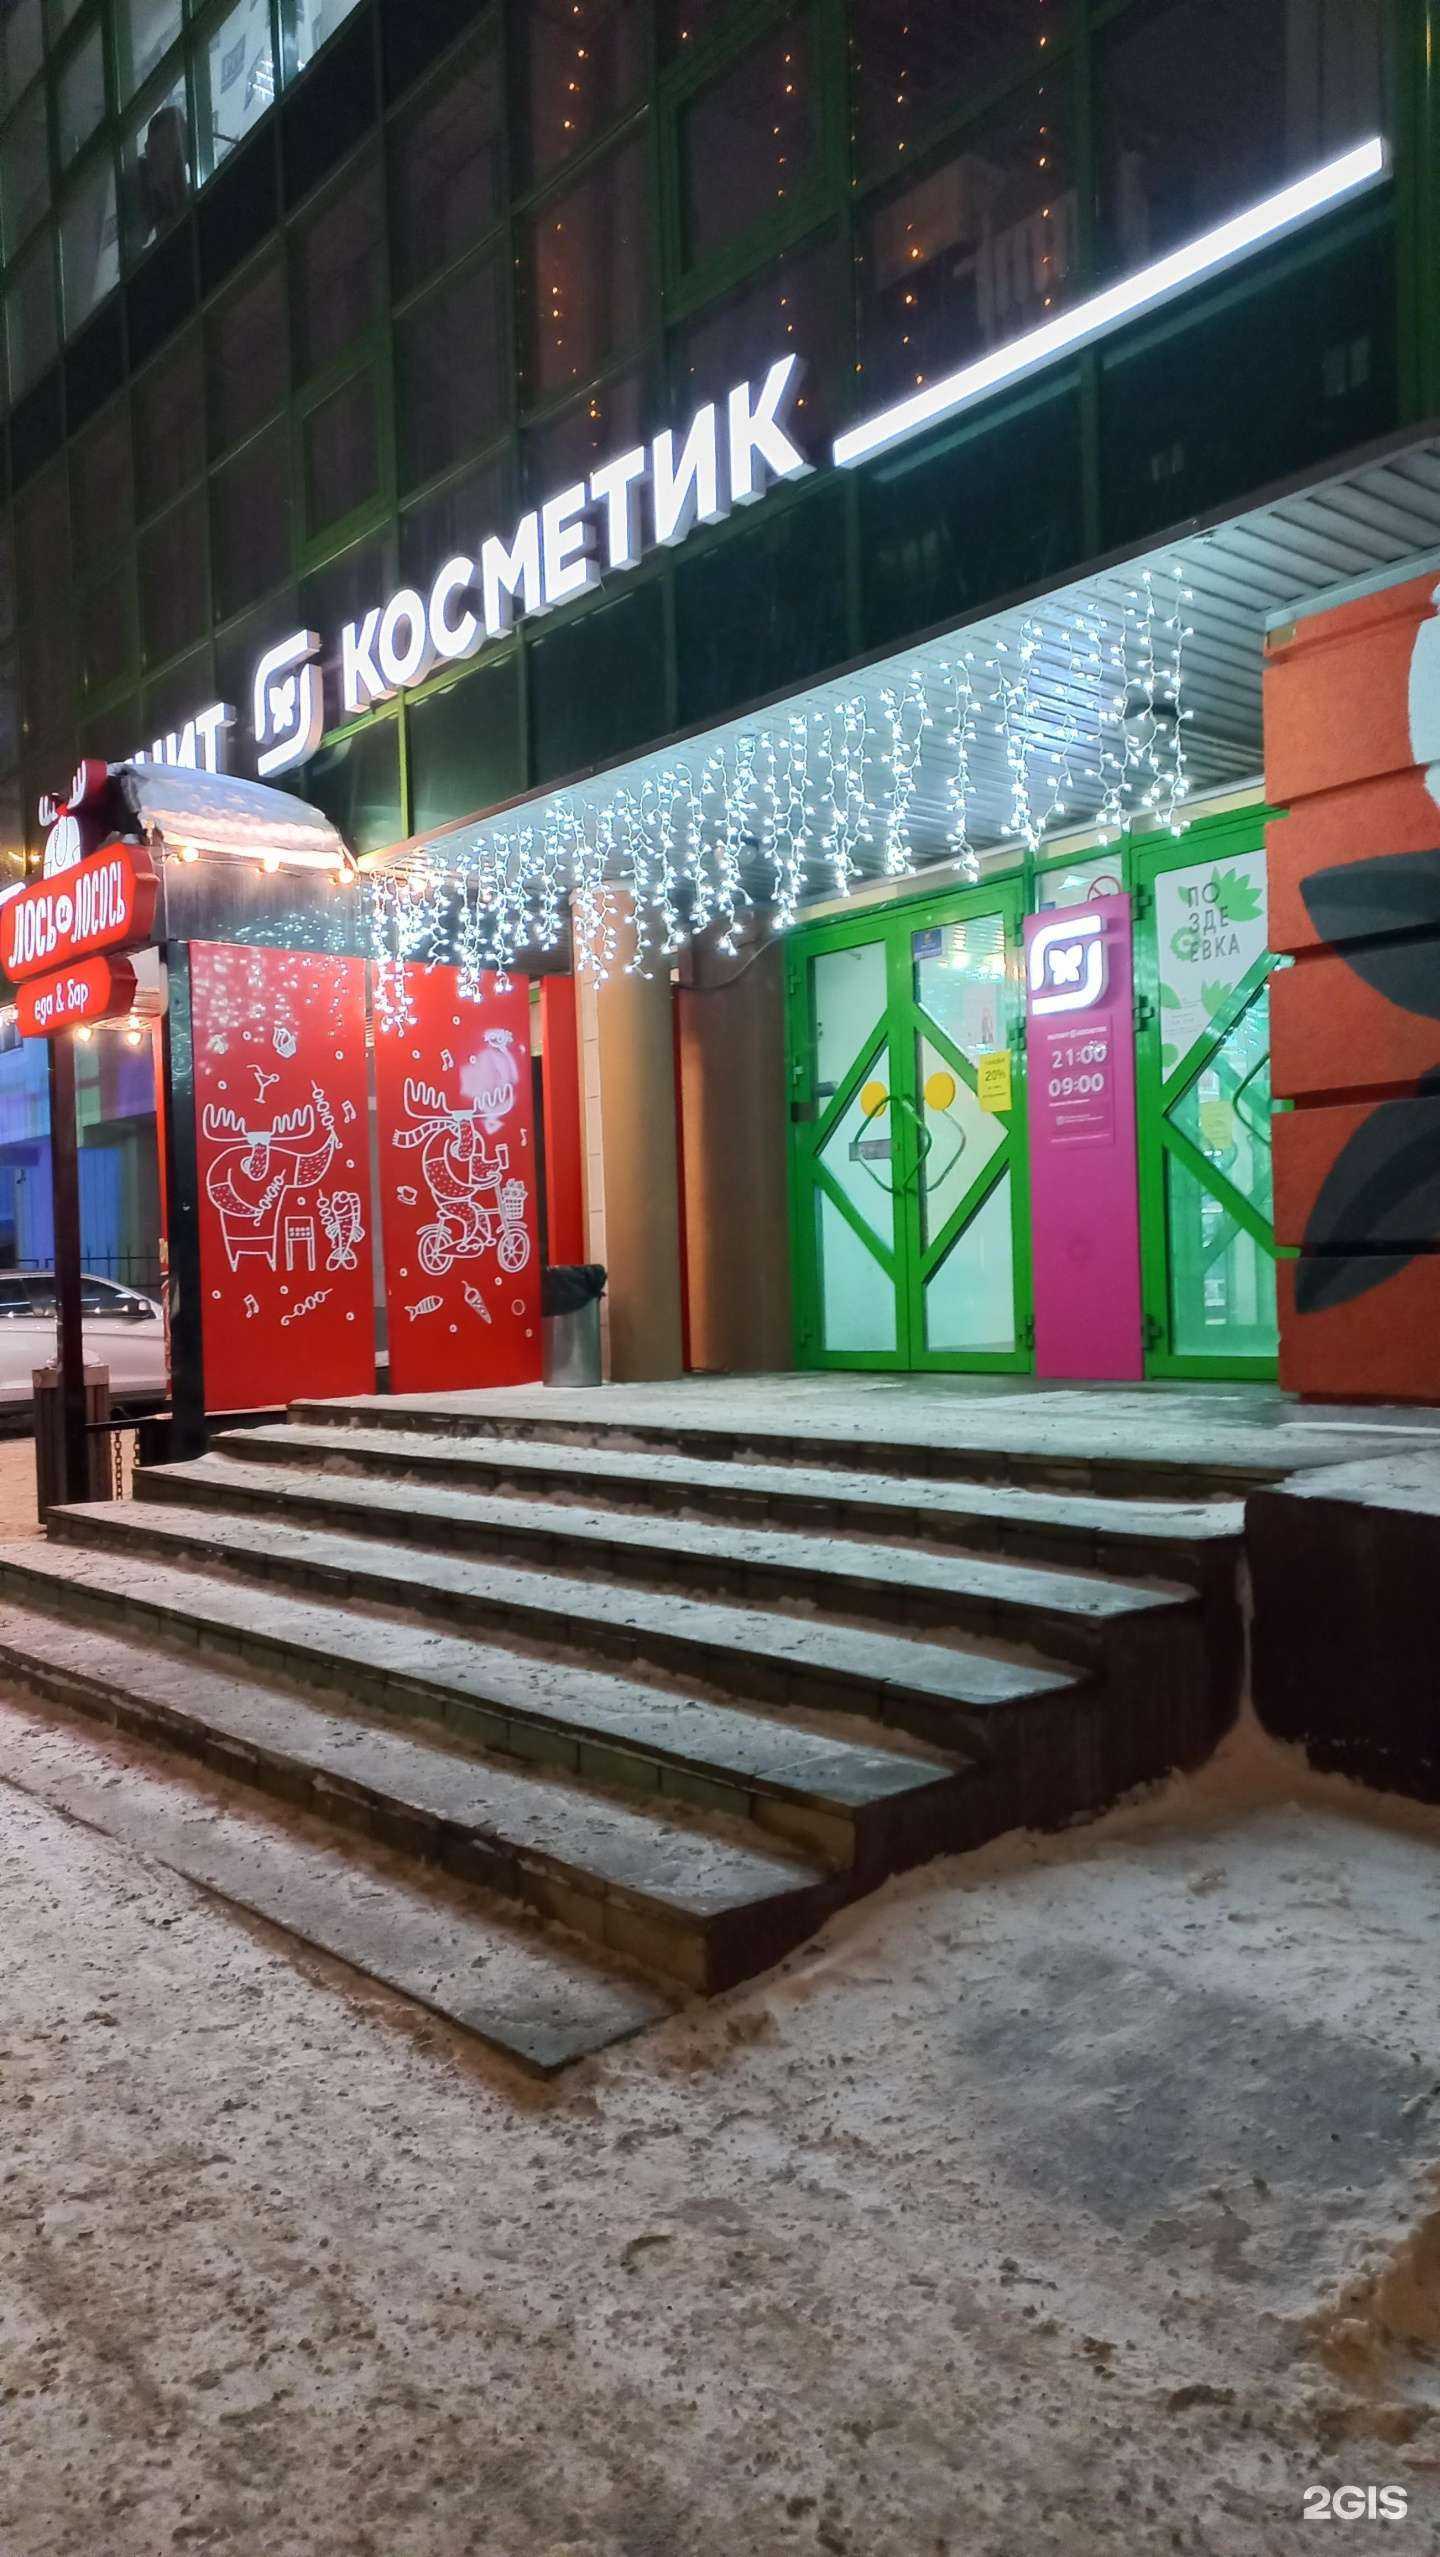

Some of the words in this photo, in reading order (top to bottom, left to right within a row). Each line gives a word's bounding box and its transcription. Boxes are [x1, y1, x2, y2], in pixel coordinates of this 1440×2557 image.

[342, 353, 808, 713] КОСМЕТИК
[1188, 882, 1220, 908] ПО
[8, 896, 57, 968] ЛОСЬ
[71, 861, 126, 944] ЛОСОСЬ
[34, 995, 53, 1025] еда
[67, 978, 89, 1013] бар
[1052, 1043, 1107, 1068] 21:00
[1048, 1073, 1104, 1097] 09:00
